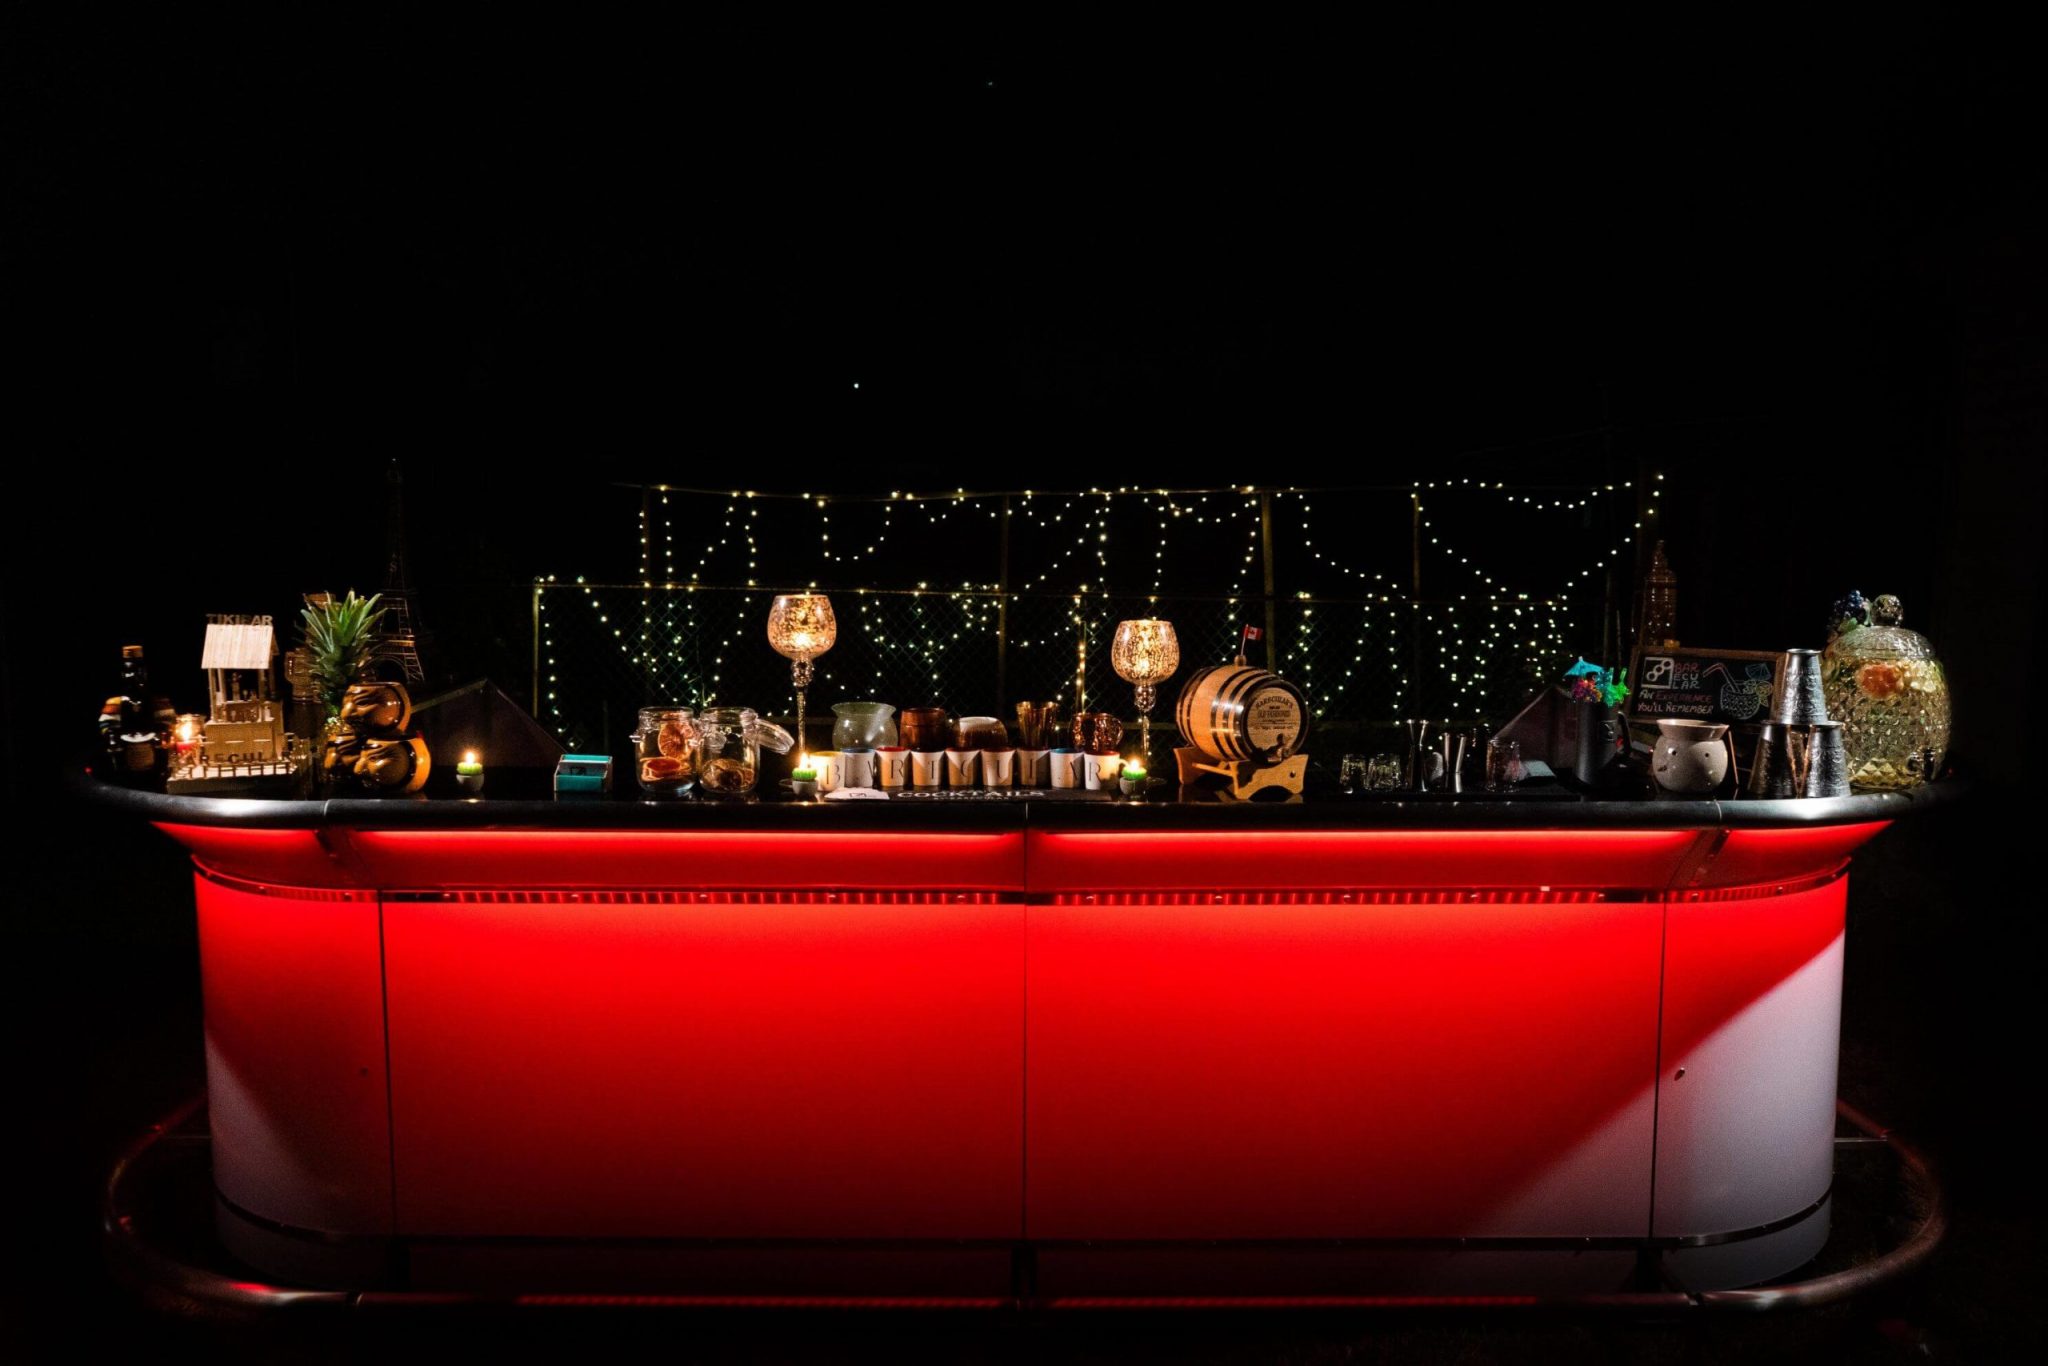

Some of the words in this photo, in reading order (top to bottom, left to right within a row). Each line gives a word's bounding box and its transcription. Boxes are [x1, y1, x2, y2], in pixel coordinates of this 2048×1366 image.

[1674, 662, 1700, 673] BAR
[1673, 672, 1700, 682] ECU
[1673, 680, 1701, 690] LAR
[1666, 701, 1714, 715] REMEMBER
